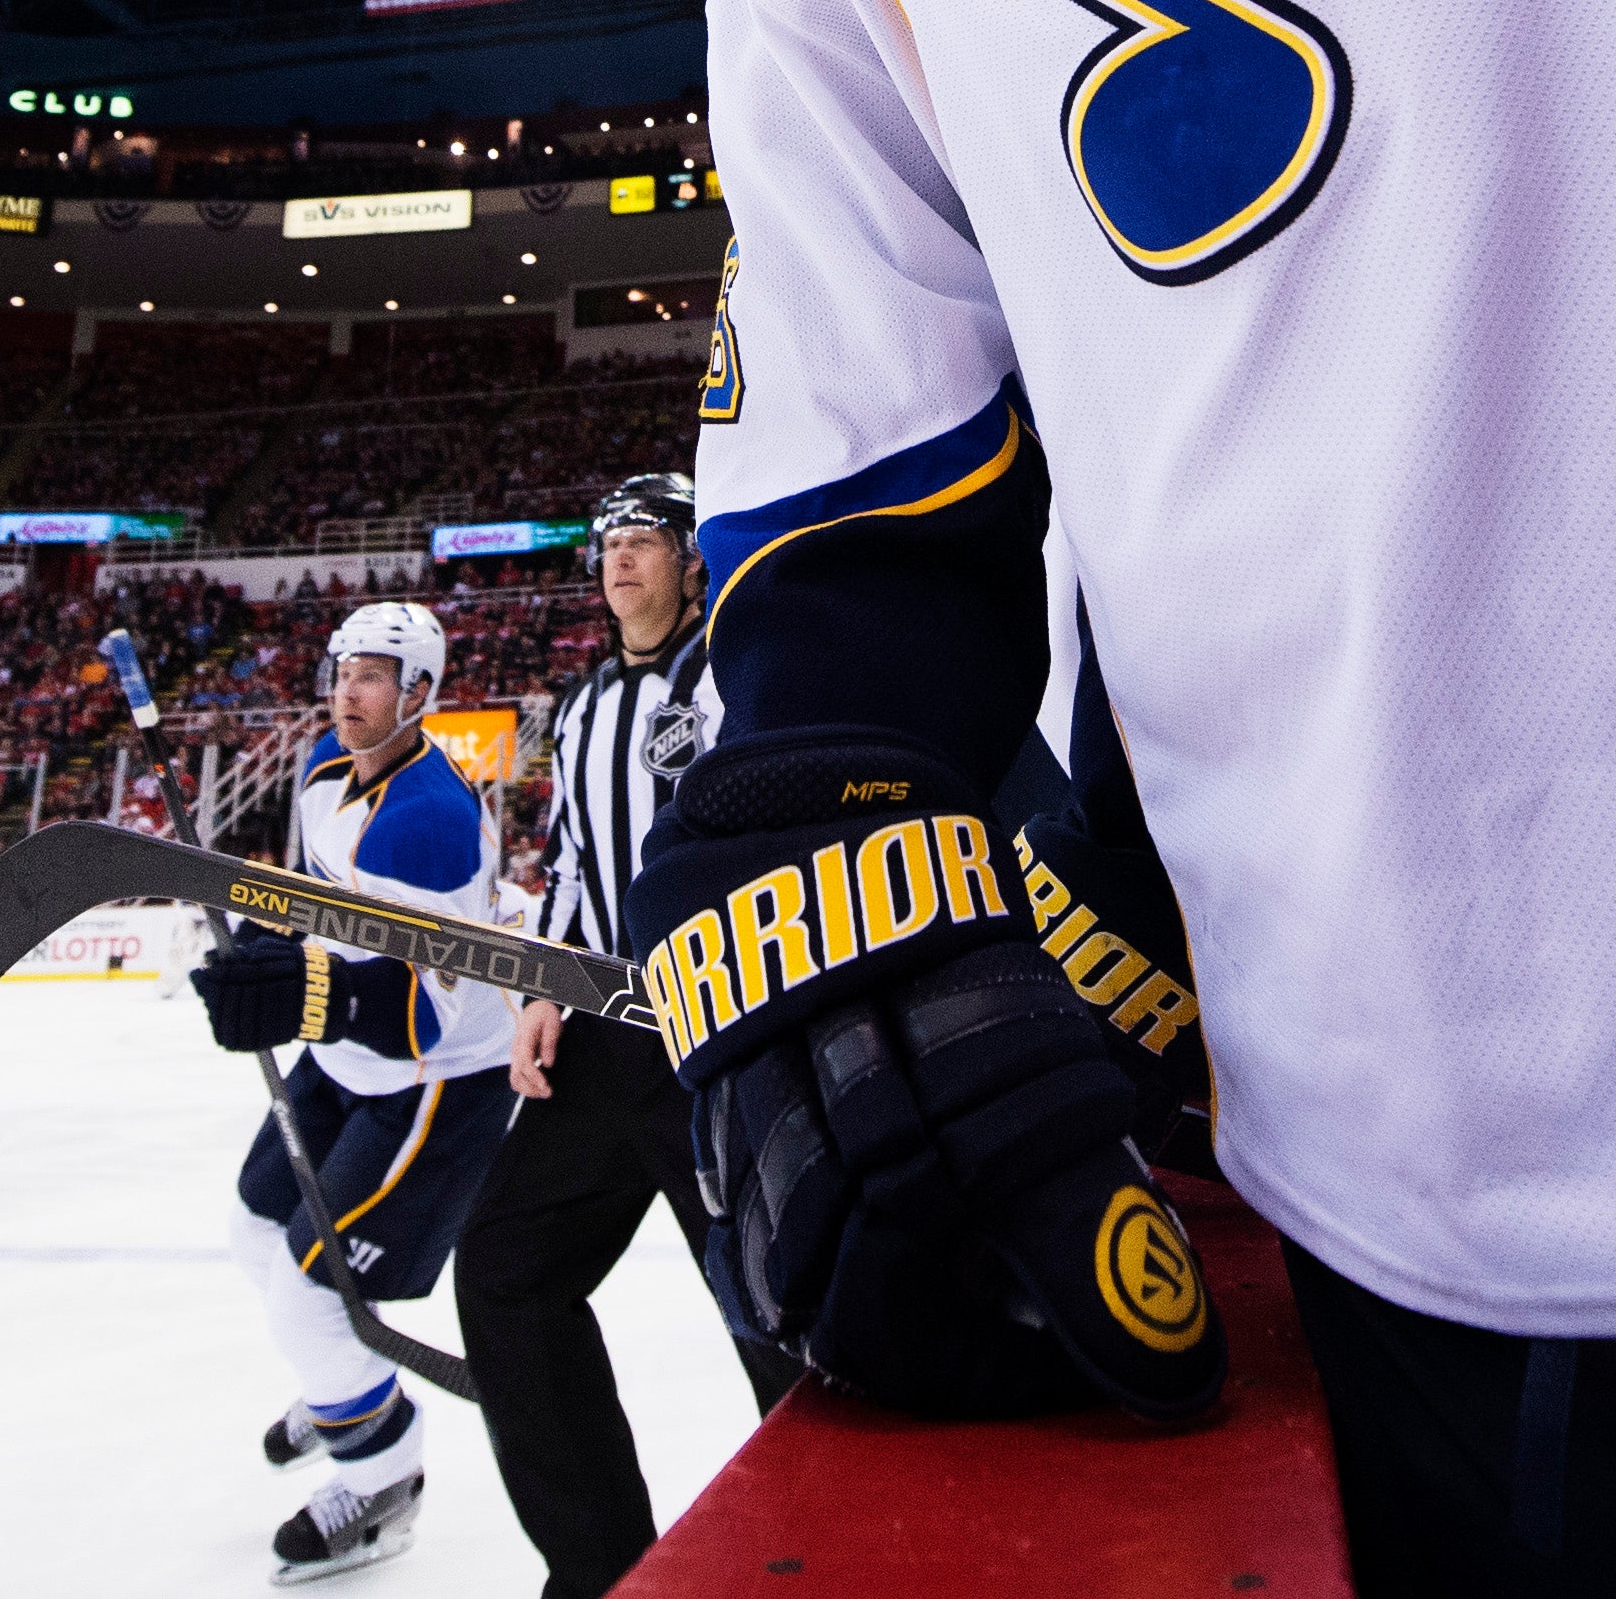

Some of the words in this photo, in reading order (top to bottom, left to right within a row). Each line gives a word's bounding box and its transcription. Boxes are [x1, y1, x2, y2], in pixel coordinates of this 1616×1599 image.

[8, 88, 134, 119] CLUB
[303, 200, 355, 222] SVS
[364, 202, 452, 219] VISION
[651, 720, 694, 762] NHL
[841, 781, 912, 803] MPS
[229, 882, 291, 916] NXG
[288, 899, 557, 995] TOTALONE
[640, 813, 1011, 1075] ARRIOR
[297, 944, 332, 1042] ARRIOR
